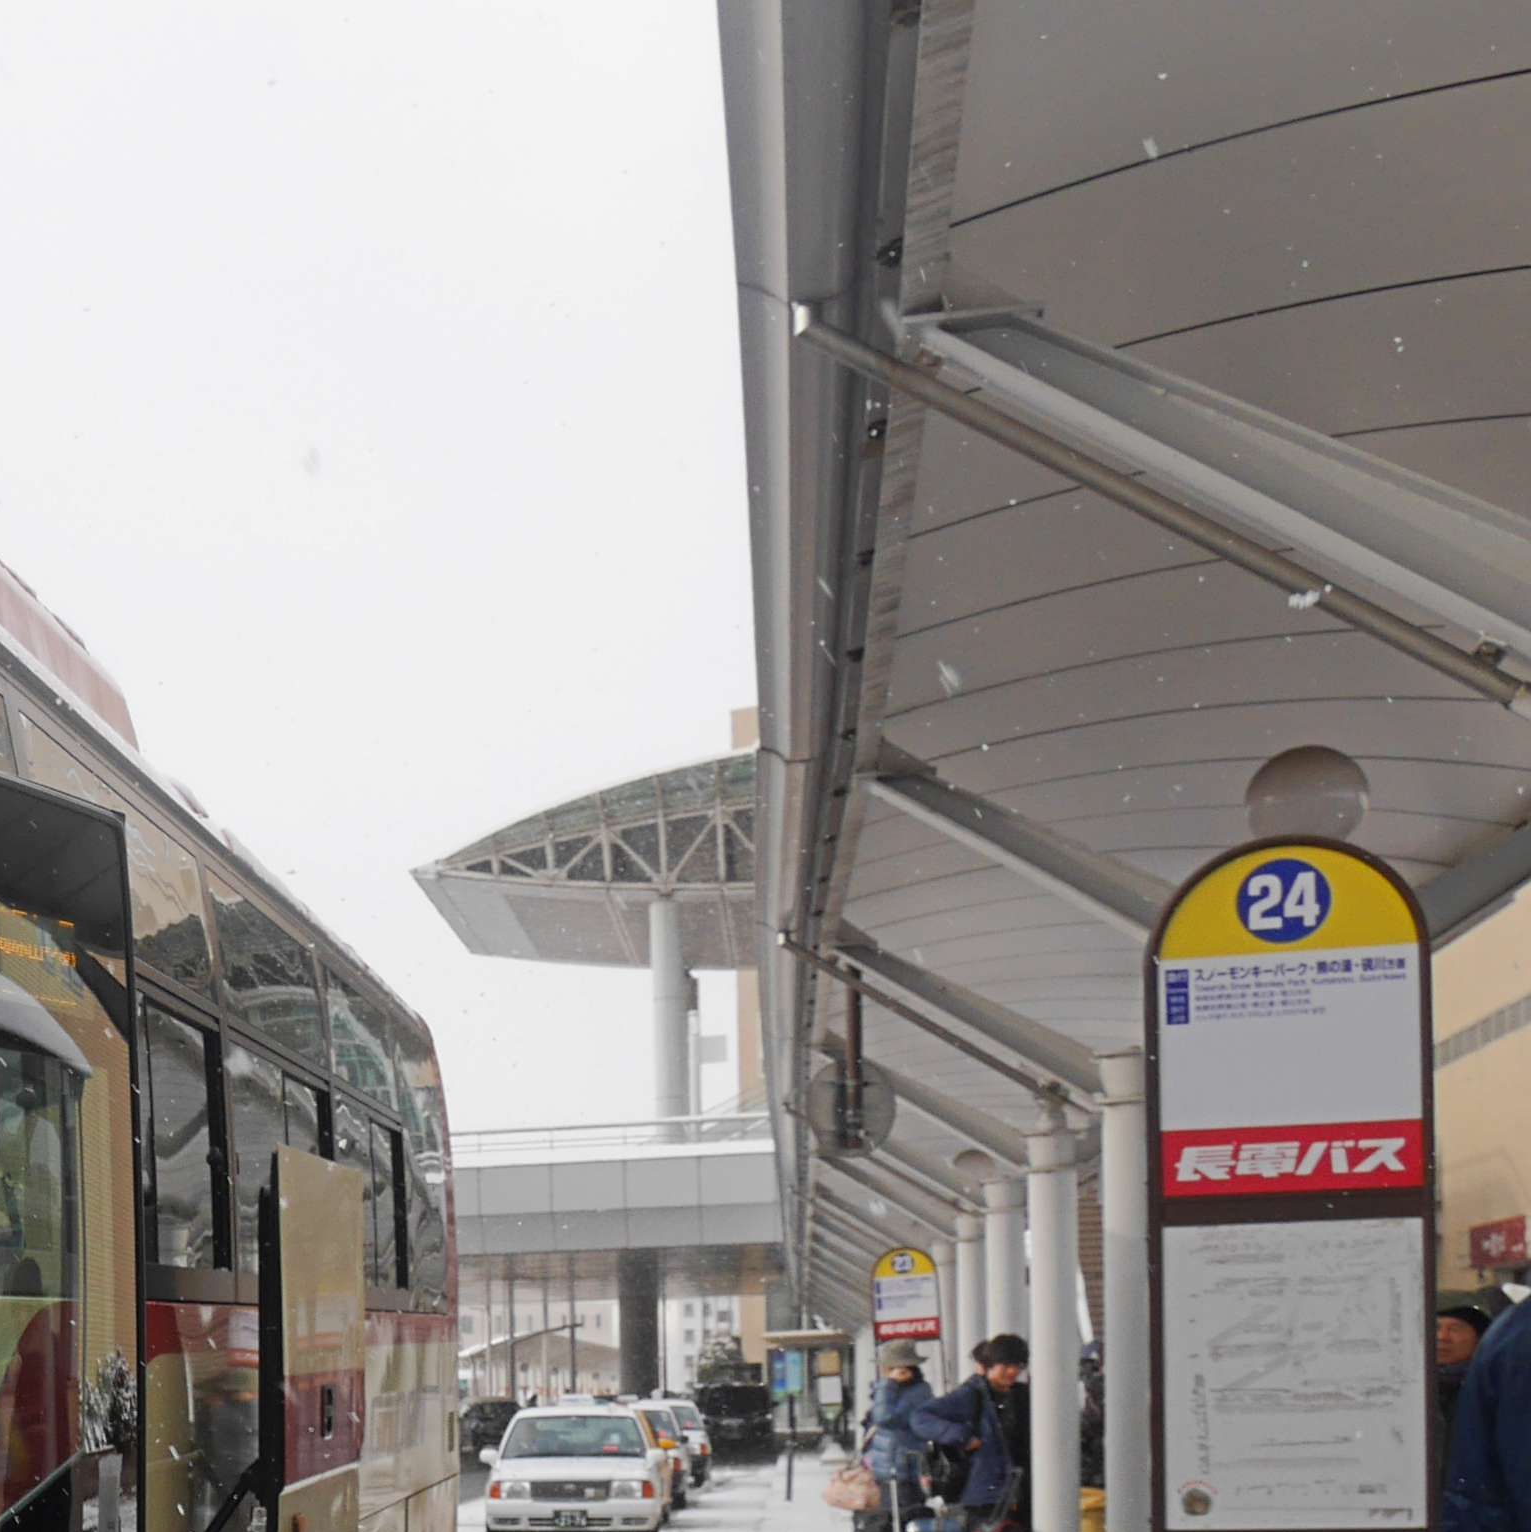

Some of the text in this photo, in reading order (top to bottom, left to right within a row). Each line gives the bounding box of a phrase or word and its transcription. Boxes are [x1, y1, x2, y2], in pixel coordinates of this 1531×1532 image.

[1247, 871, 1321, 931] 24
[1174, 1137, 1407, 1182] 長電バス
